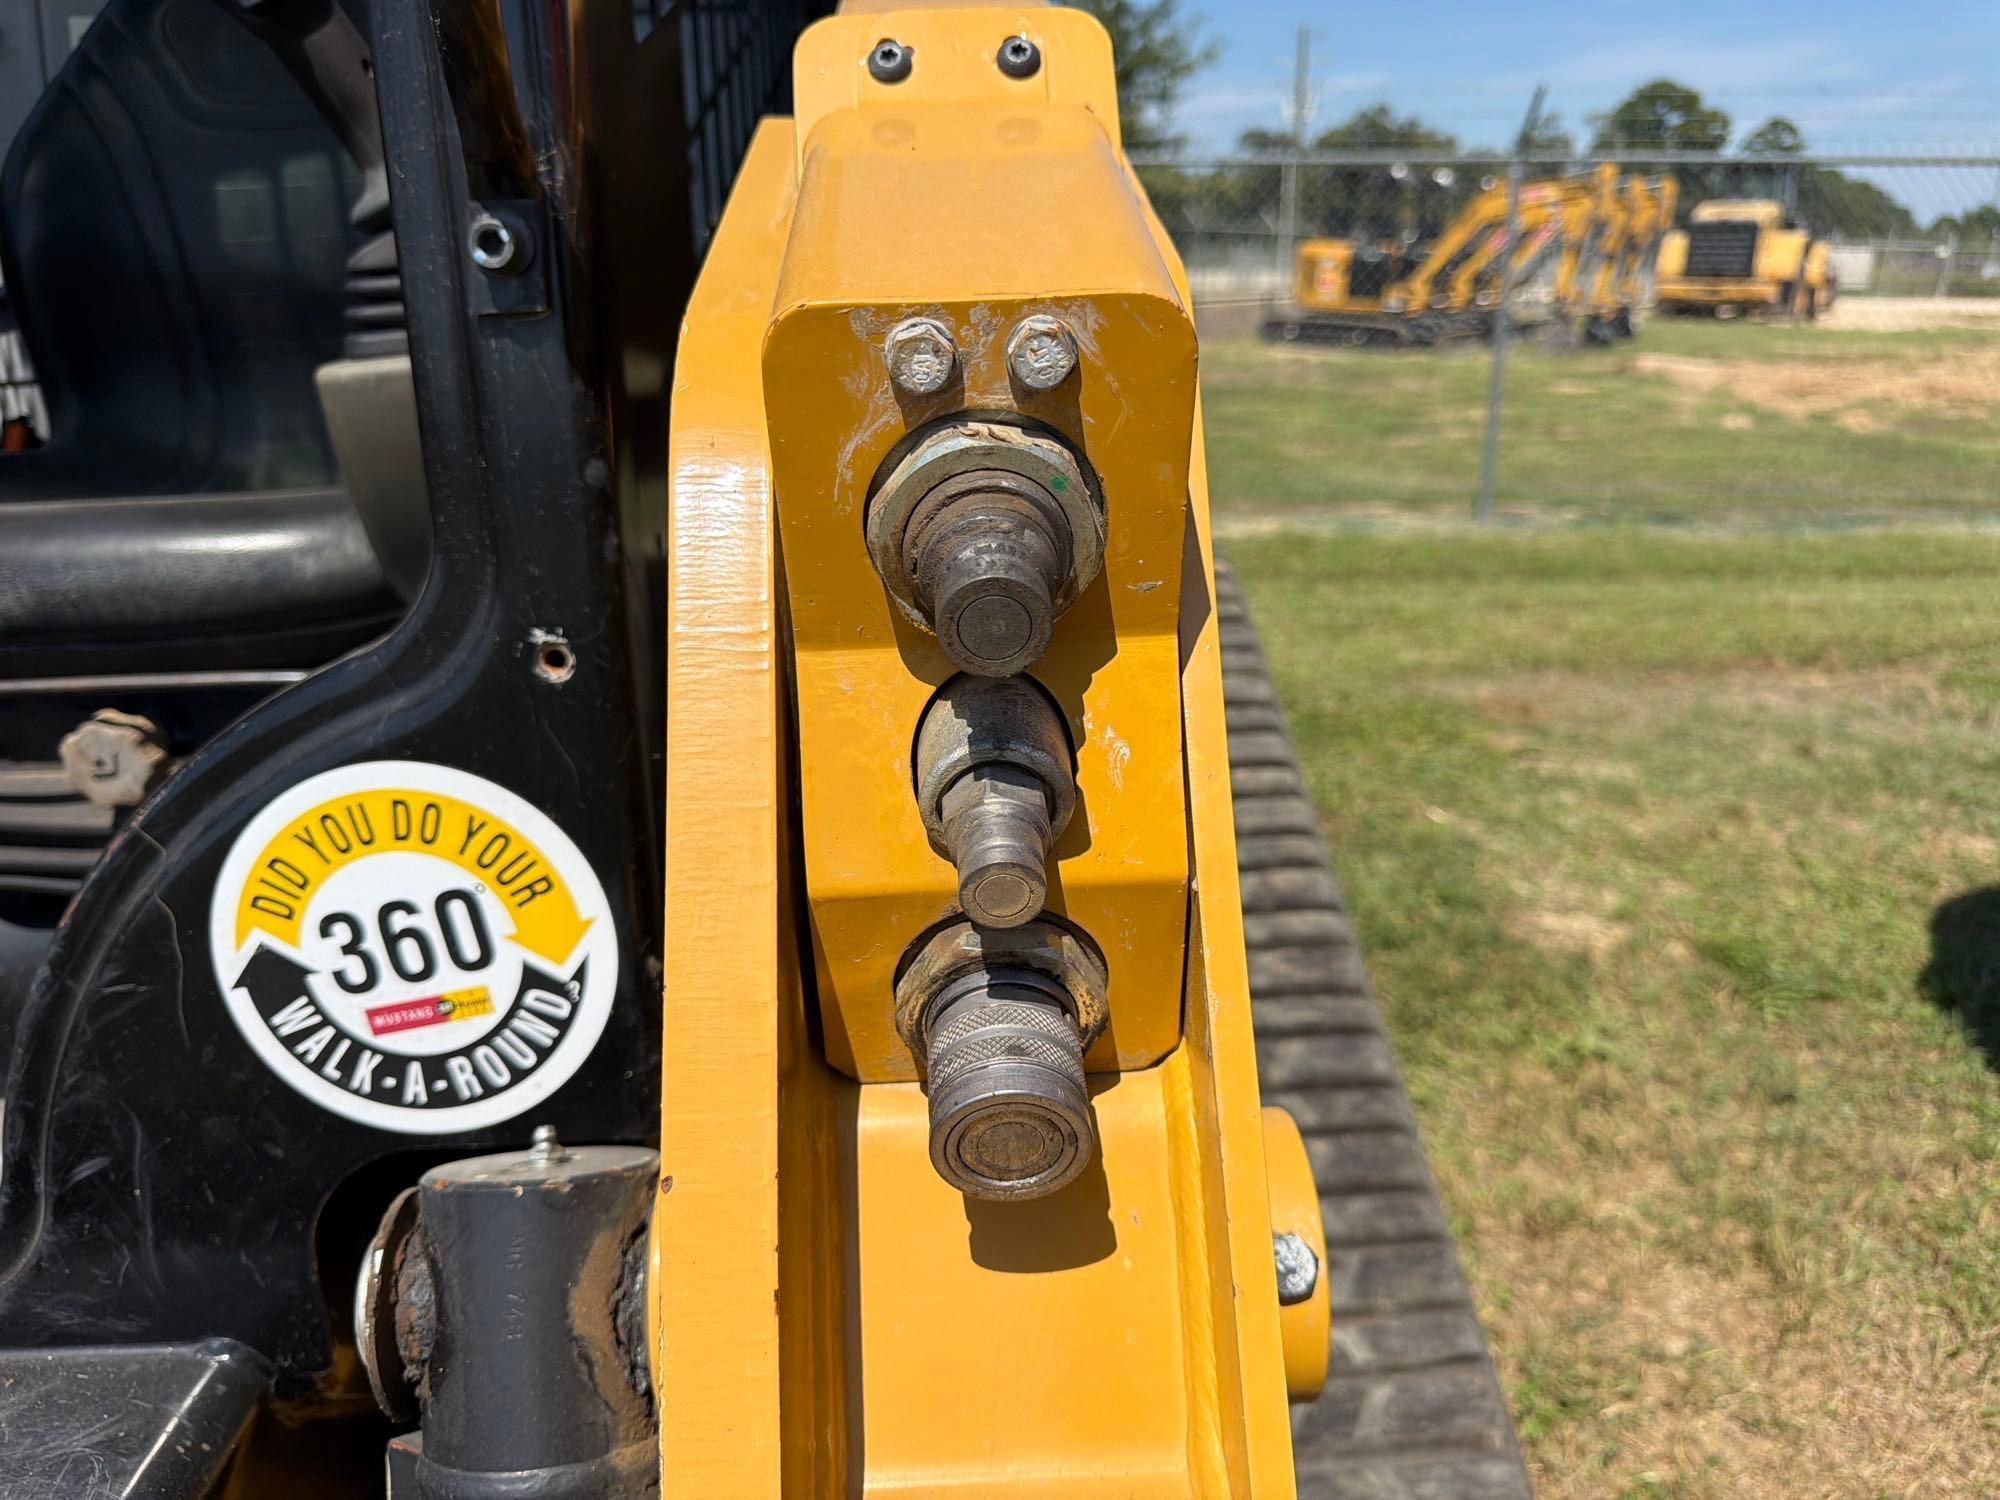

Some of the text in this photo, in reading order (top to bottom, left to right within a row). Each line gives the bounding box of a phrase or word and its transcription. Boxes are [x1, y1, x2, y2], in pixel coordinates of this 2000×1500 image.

[250, 798, 556, 921] DID YOU DO YOUR
[372, 1004, 435, 1028] MUSTANG
